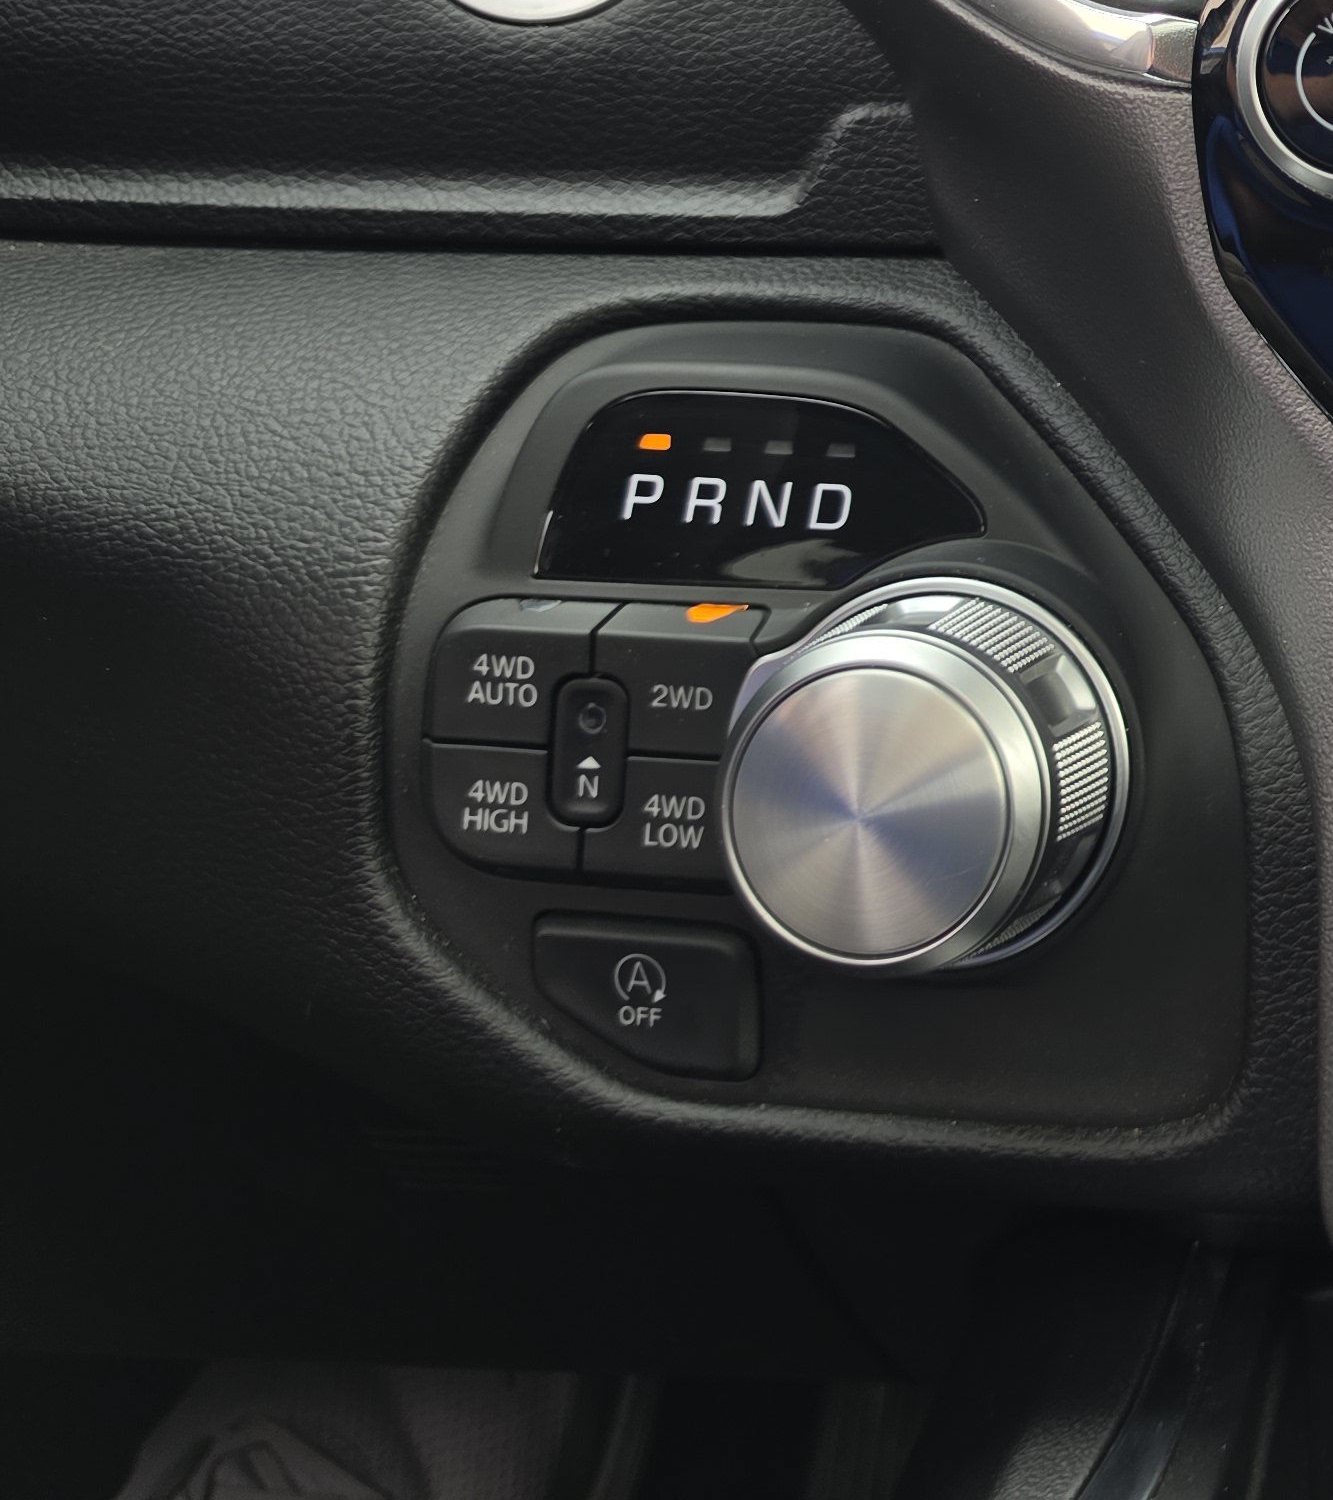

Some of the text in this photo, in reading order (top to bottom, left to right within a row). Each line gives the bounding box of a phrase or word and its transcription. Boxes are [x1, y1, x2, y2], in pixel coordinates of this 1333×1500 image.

[622, 474, 852, 531] P R N D
[472, 653, 535, 679] 4WD
[467, 681, 538, 708] AUTO
[650, 683, 713, 711] 2WD
[466, 779, 529, 804] 4WD
[578, 774, 599, 799] N
[643, 793, 706, 819] 4WD
[462, 807, 529, 835] HIGH
[643, 823, 705, 849] LOW
[618, 1005, 662, 1027] OFF
